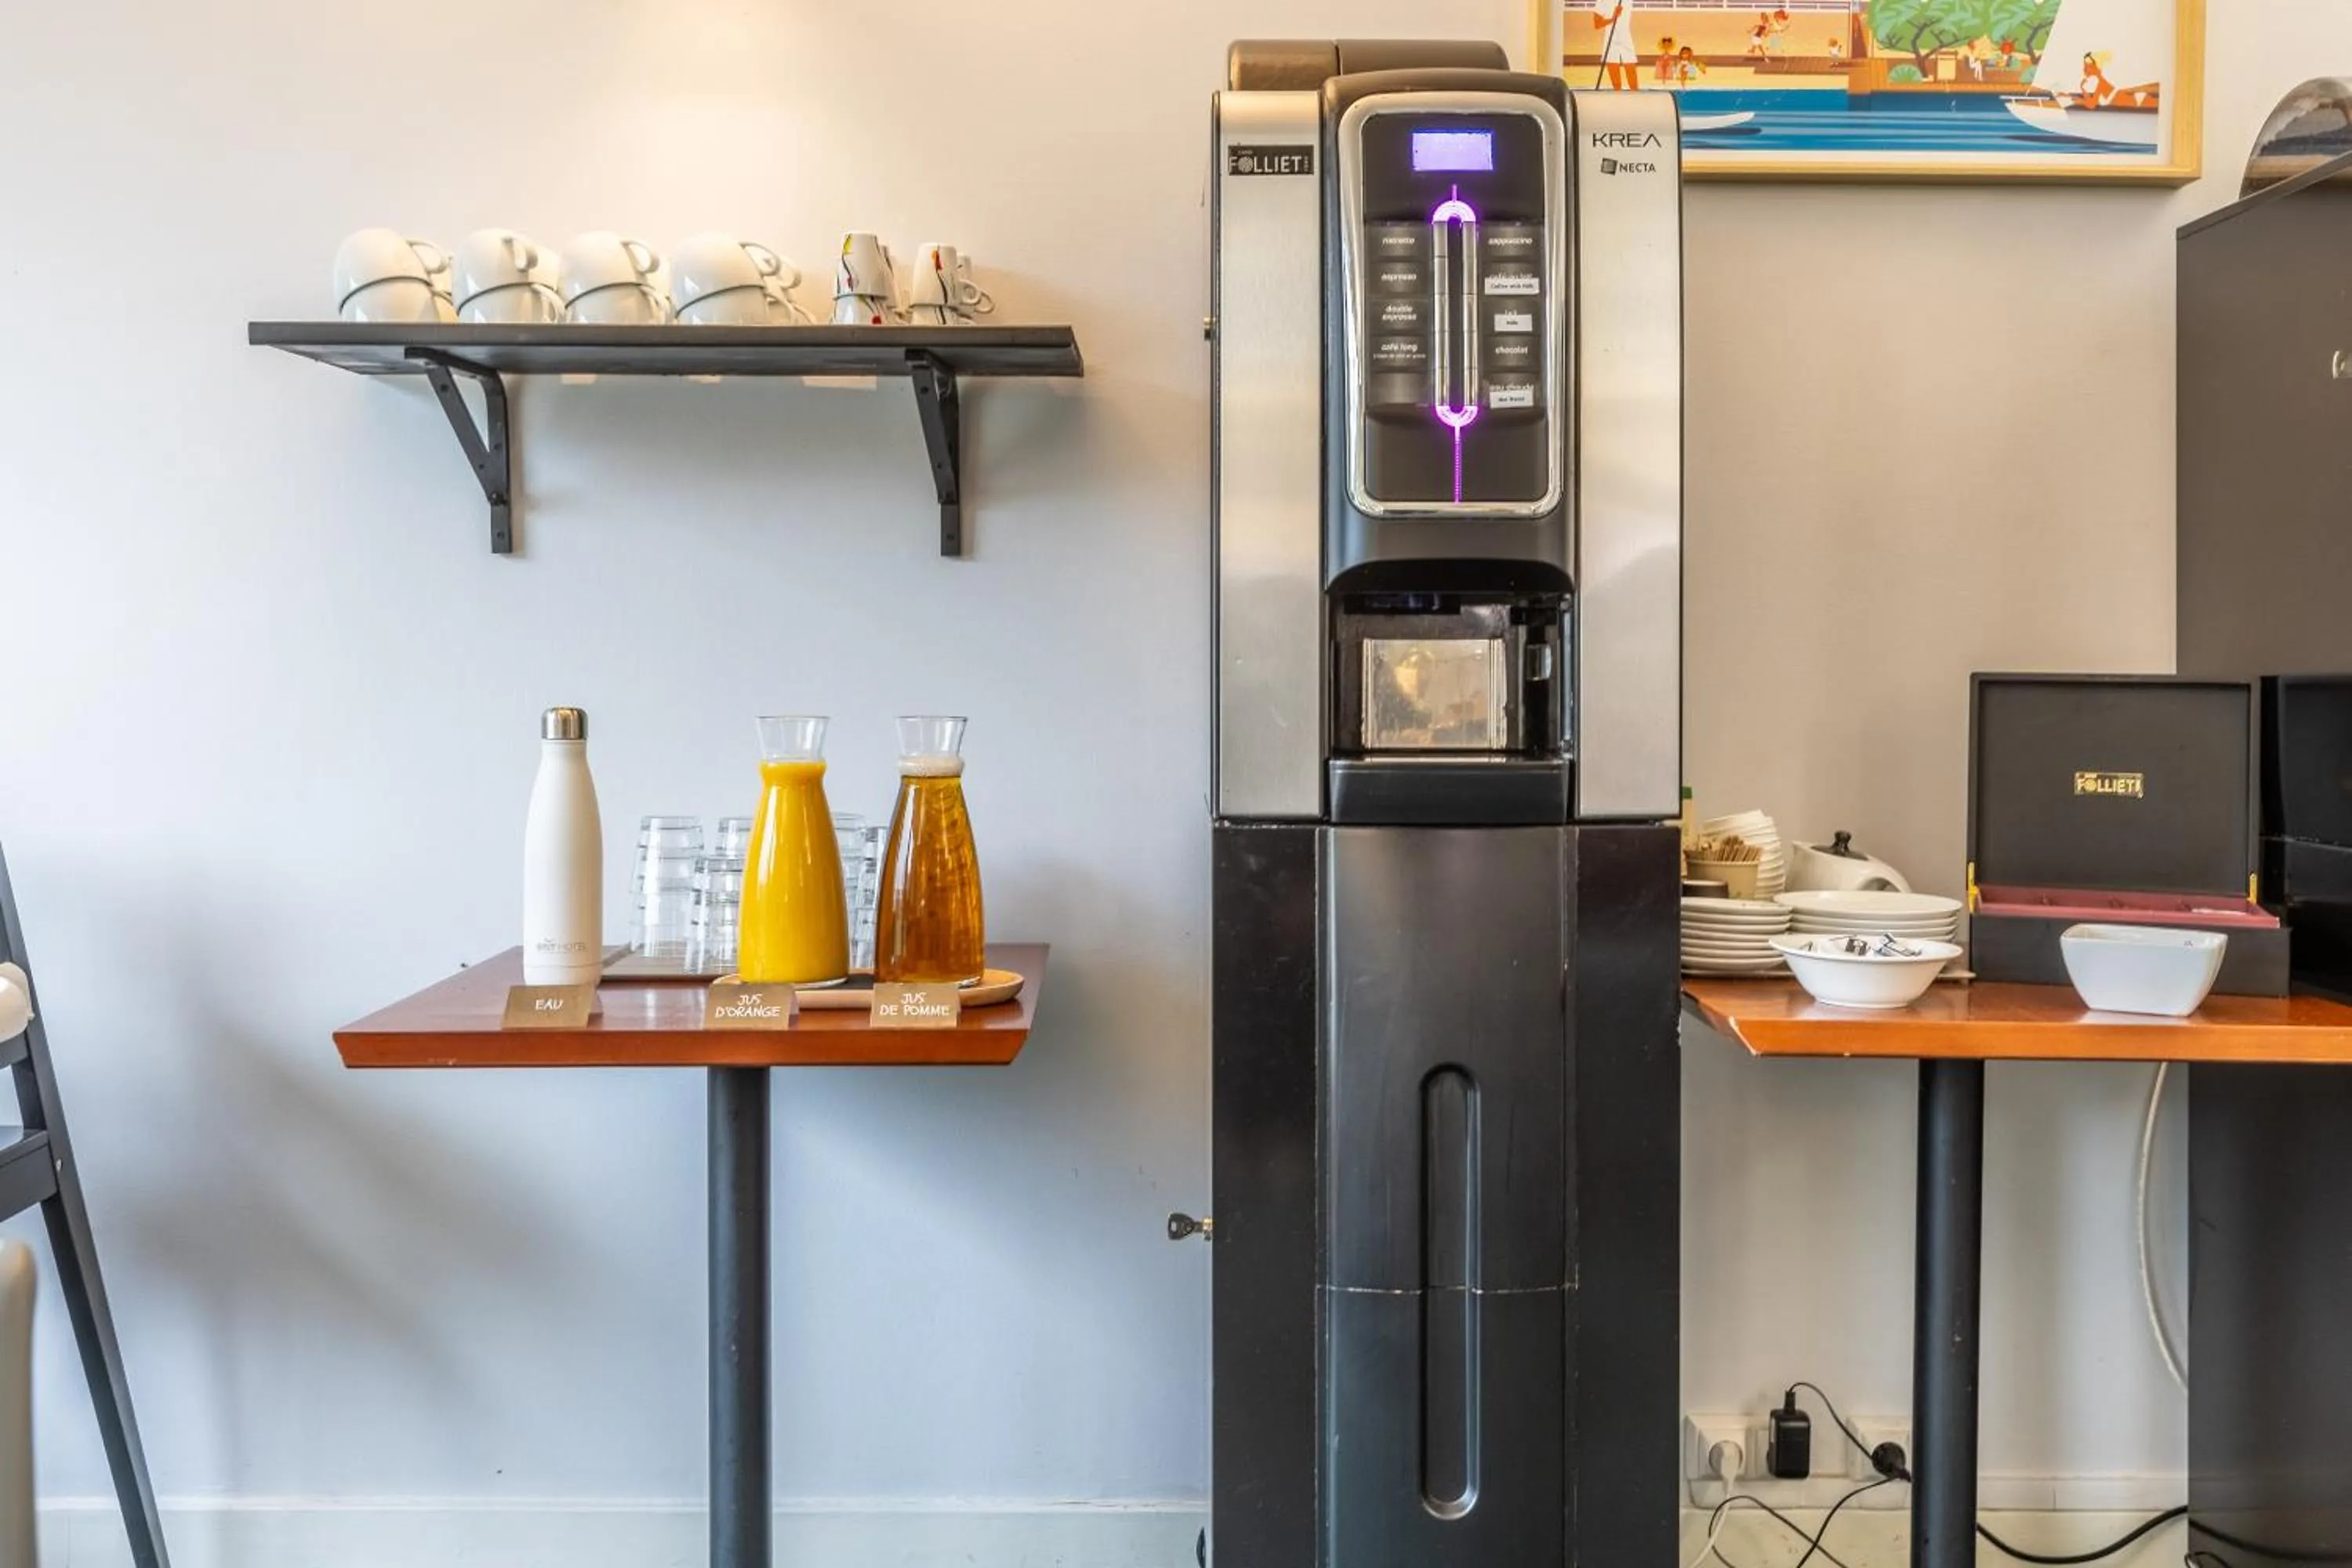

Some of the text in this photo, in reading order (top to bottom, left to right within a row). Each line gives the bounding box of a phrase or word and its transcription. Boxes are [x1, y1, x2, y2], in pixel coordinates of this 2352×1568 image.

[1592, 132, 1661, 148] KREA
[1229, 155, 1302, 172] FOLLIET
[1619, 162, 1657, 173] NECTA
[2077, 777, 2135, 793] FOLLIET
[535, 997, 564, 1011] EAU
[736, 993, 764, 1006] JUS
[900, 991, 927, 1004] JUS
[714, 1004, 782, 1018] D'ORANGE
[879, 1004, 951, 1018] DE POMME
